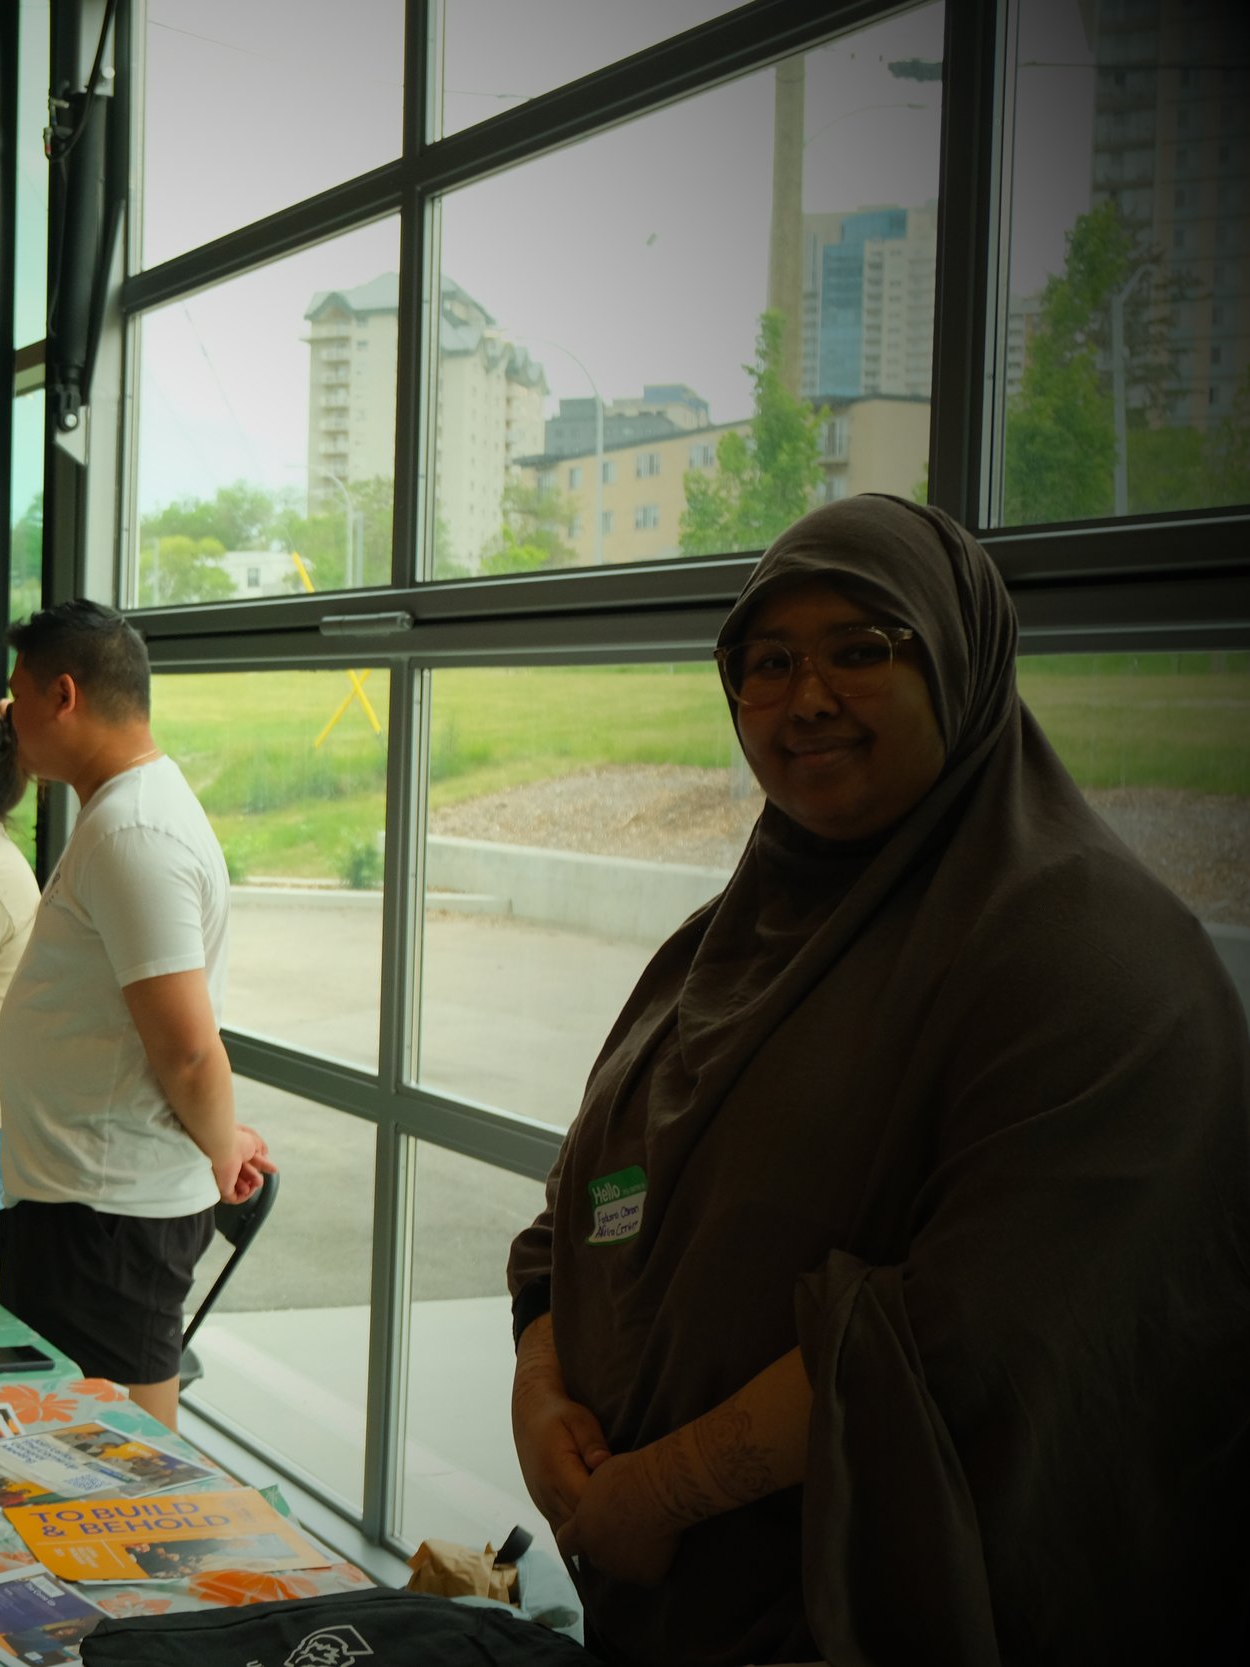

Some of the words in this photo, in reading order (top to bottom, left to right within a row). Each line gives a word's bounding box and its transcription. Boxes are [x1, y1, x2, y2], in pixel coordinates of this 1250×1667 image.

[592, 1183, 621, 1205] Hello
[30, 1510, 84, 1524] TO
[91, 1502, 200, 1520] BUILD
[42, 1525, 66, 1537] &
[79, 1515, 231, 1535] BEHOLD
